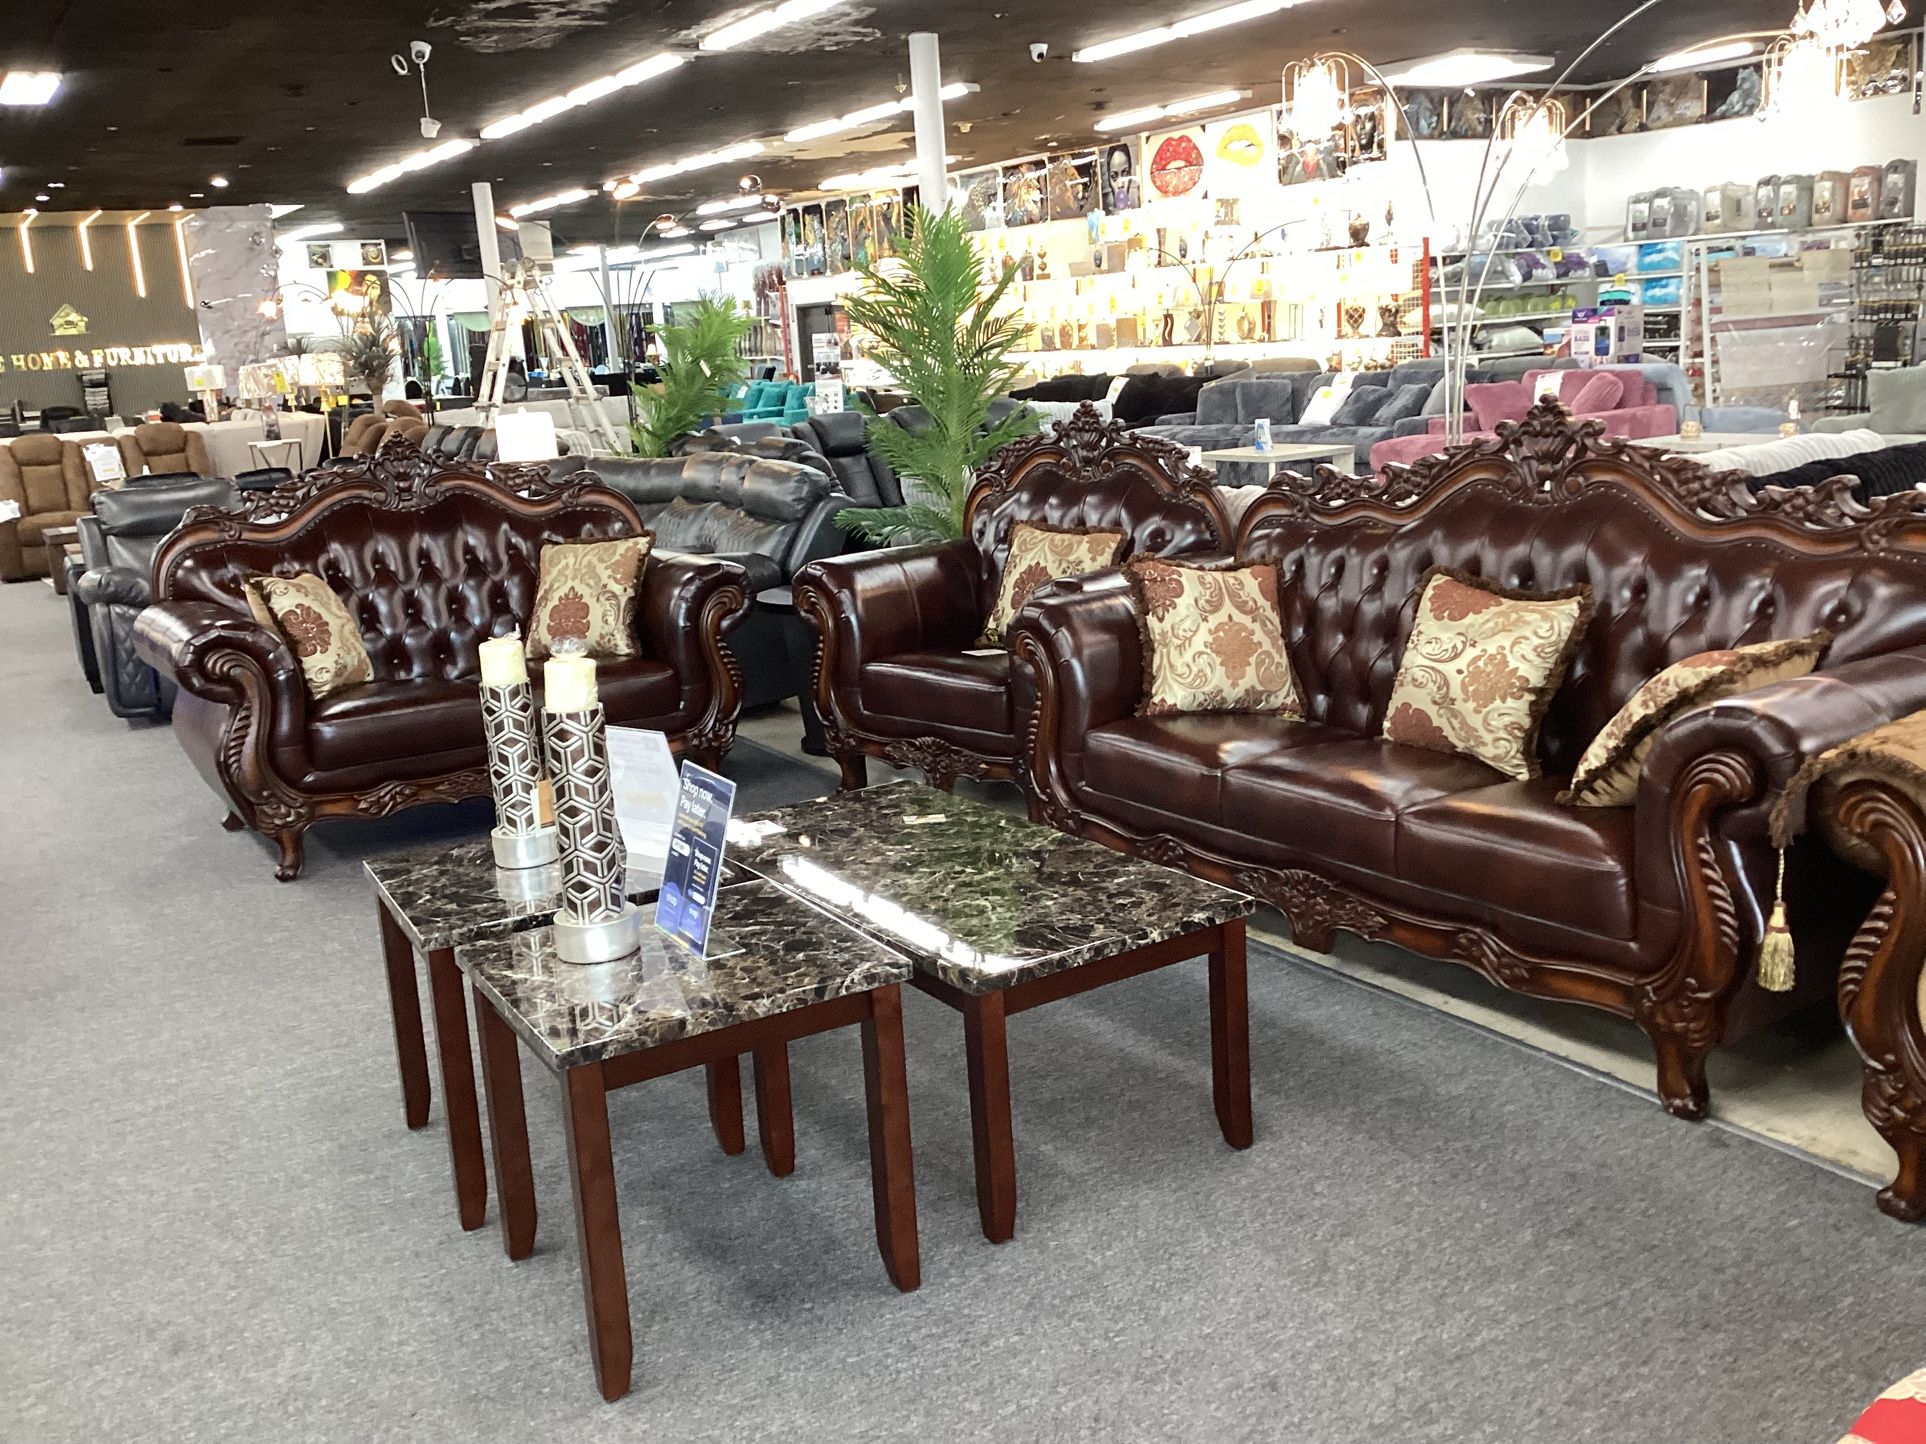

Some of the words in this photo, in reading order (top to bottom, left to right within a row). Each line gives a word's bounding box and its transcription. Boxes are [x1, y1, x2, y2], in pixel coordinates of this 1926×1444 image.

[11, 352, 71, 371] HOME
[75, 350, 89, 368] &
[683, 779, 699, 798] Shop
[680, 794, 692, 813] Pay
